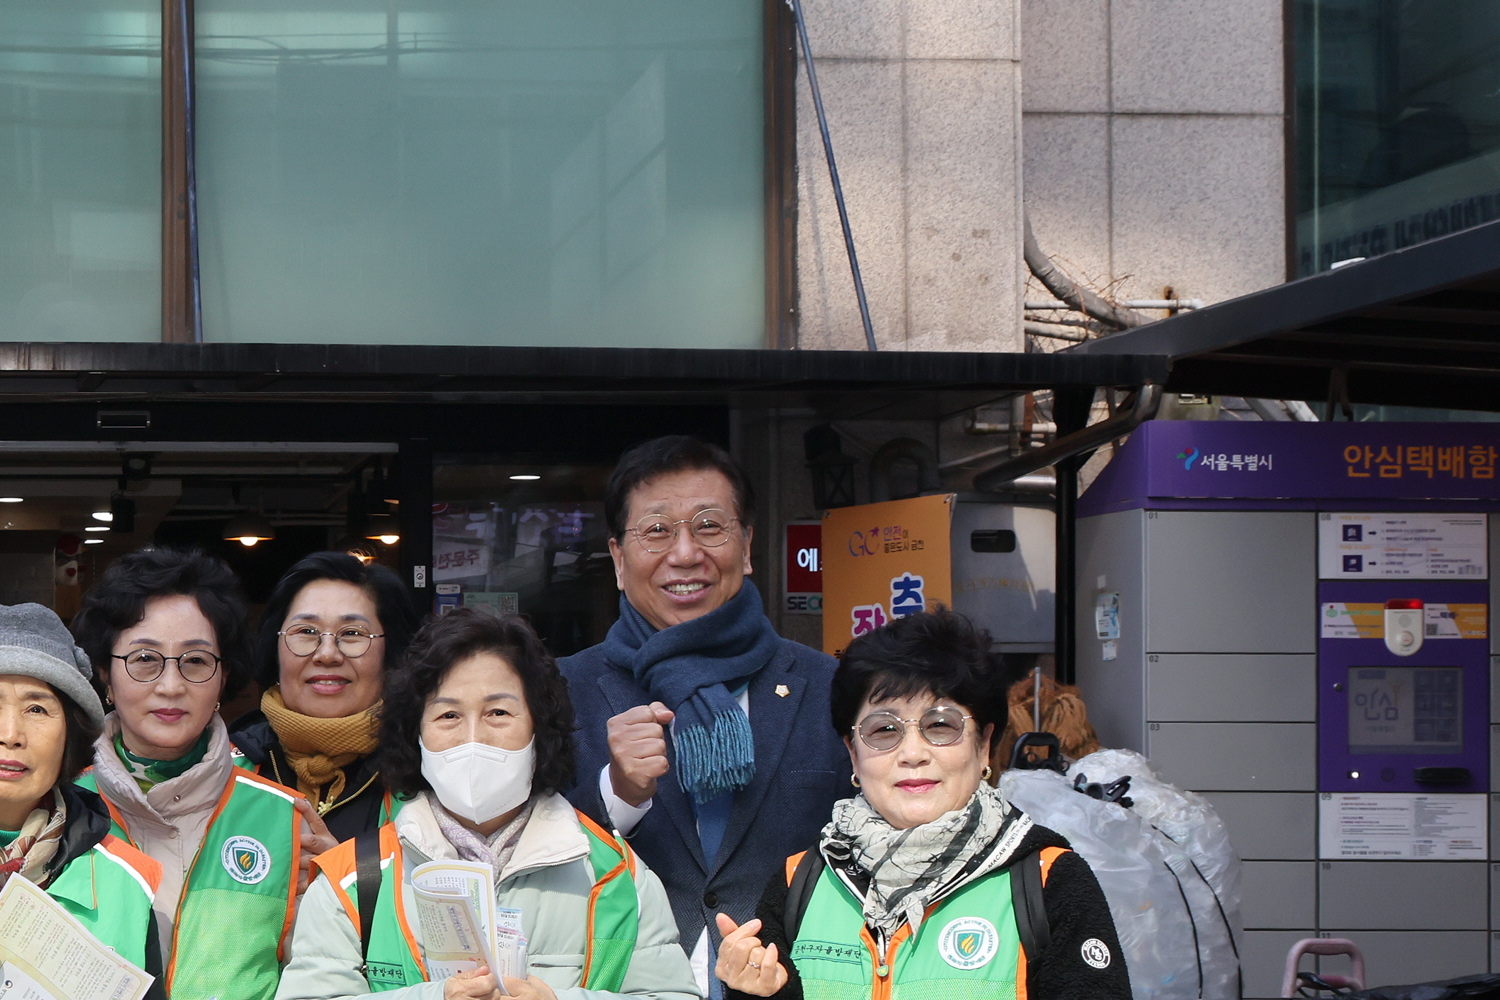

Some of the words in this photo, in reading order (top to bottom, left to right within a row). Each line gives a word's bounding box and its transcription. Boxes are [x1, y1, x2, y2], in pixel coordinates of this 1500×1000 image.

[1201, 453, 1273, 471] 서울특별시
[1343, 444, 1498, 480] 안심택배함
[797, 547, 823, 572] 에
[787, 596, 822, 611] SEC
